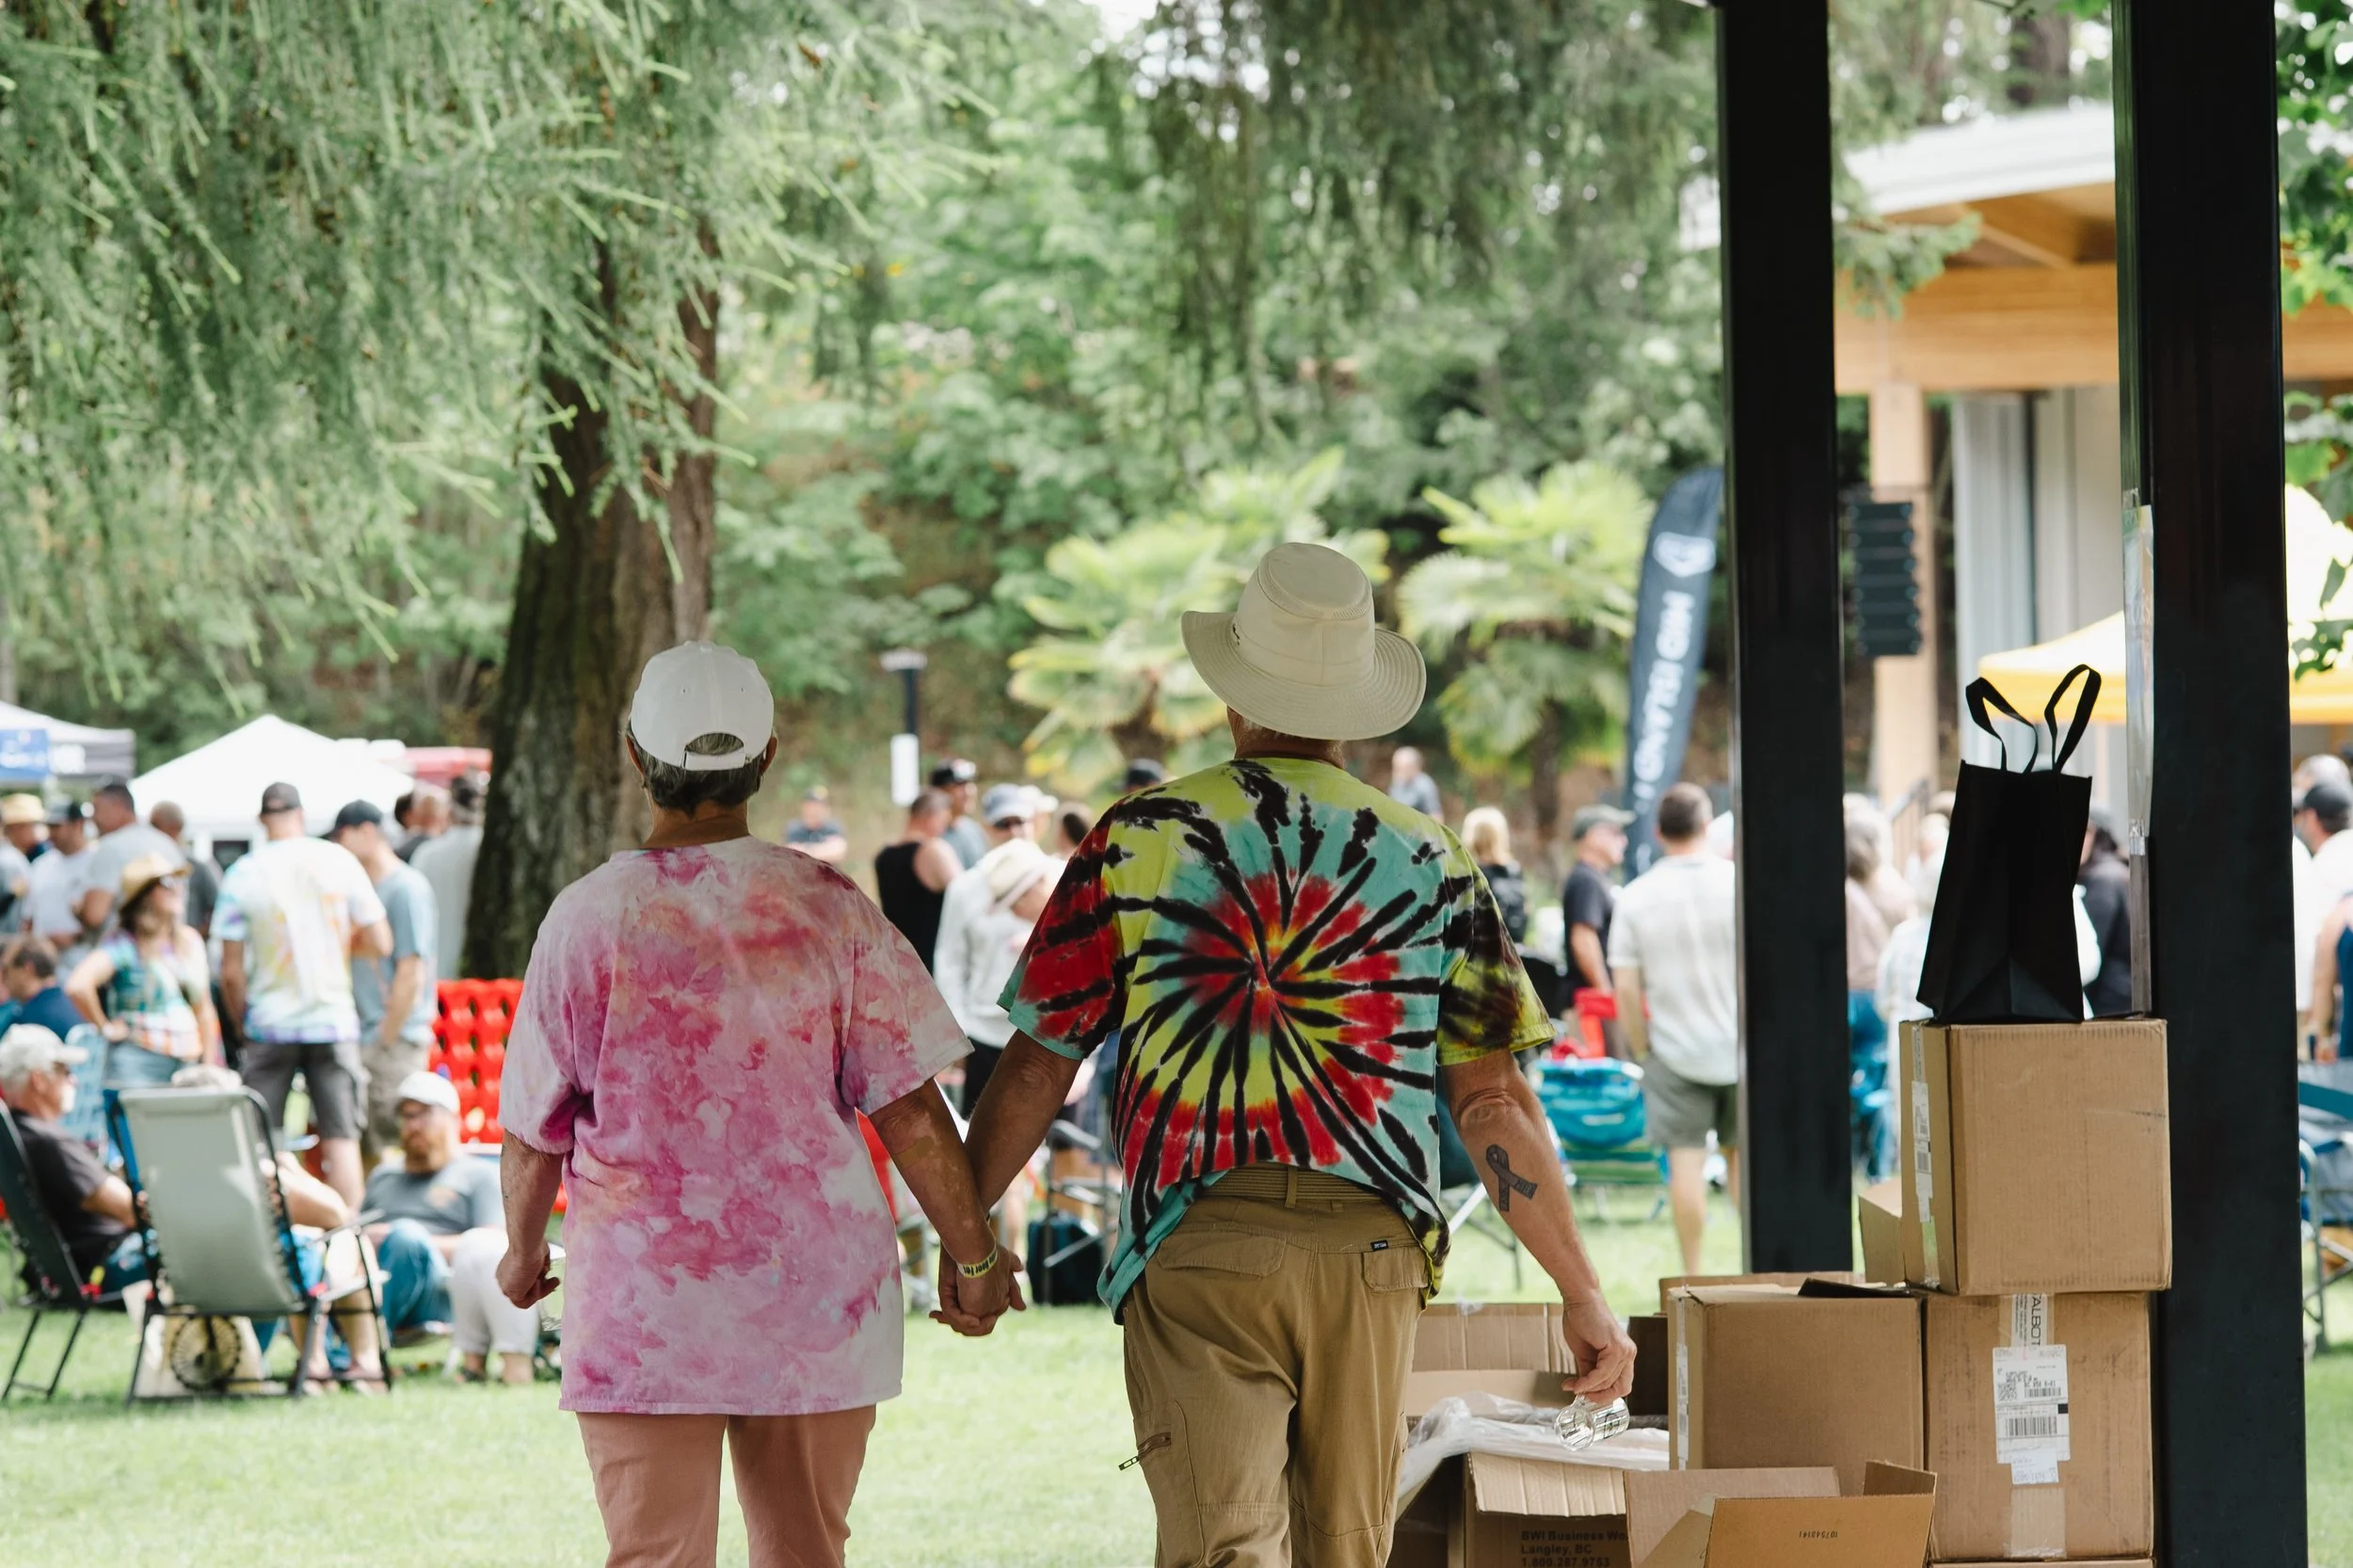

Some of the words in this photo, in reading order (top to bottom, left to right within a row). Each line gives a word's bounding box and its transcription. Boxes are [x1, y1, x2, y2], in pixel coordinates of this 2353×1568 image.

[1634, 659, 1684, 783] ISLAND
[1521, 1530, 1545, 1541] BWI
[1548, 1530, 1604, 1541] Business
[1606, 1530, 1629, 1541] Wo
[1575, 1544, 1593, 1555] BC
